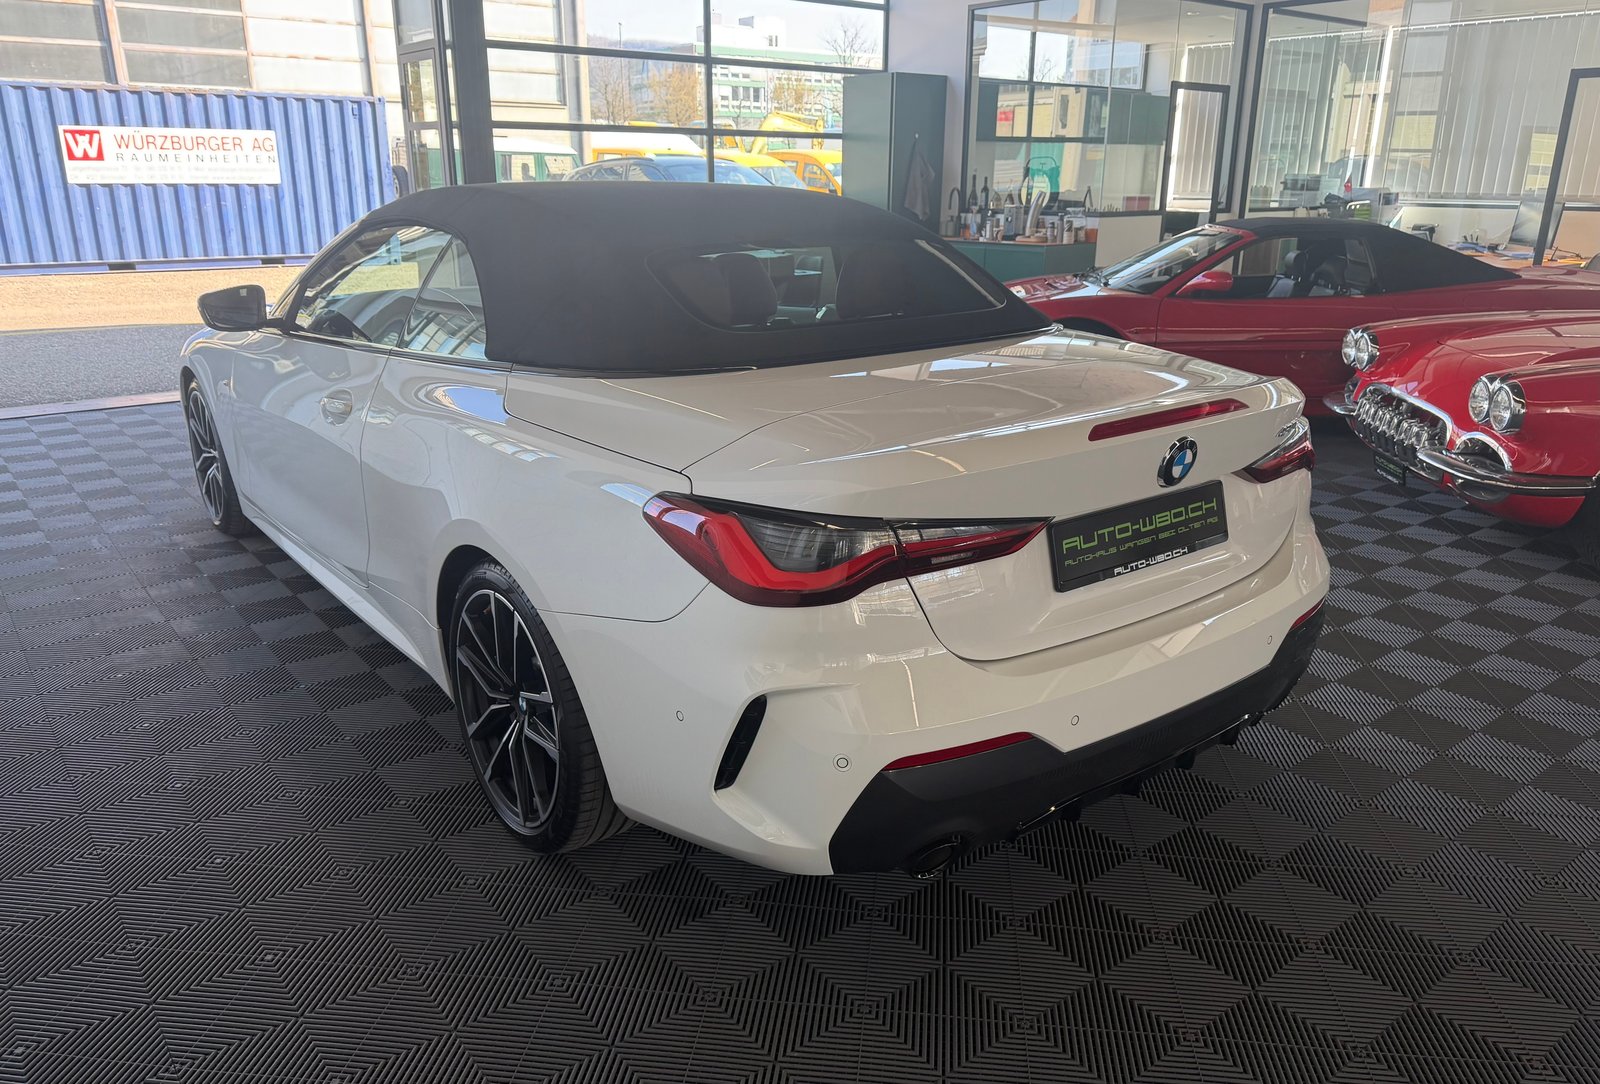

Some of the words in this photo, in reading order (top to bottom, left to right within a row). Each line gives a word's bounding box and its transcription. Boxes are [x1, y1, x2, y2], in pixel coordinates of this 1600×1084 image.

[113, 130, 243, 151] WÜRZBURGER
[252, 136, 275, 152] AG
[115, 153, 276, 164] RAUMEINHEITEN
[1062, 497, 1217, 554] AUTO-WBO.CH
[1064, 546, 1117, 567] AUTOHAUS
[1114, 546, 1188, 576] AUTO-WBO.CH
